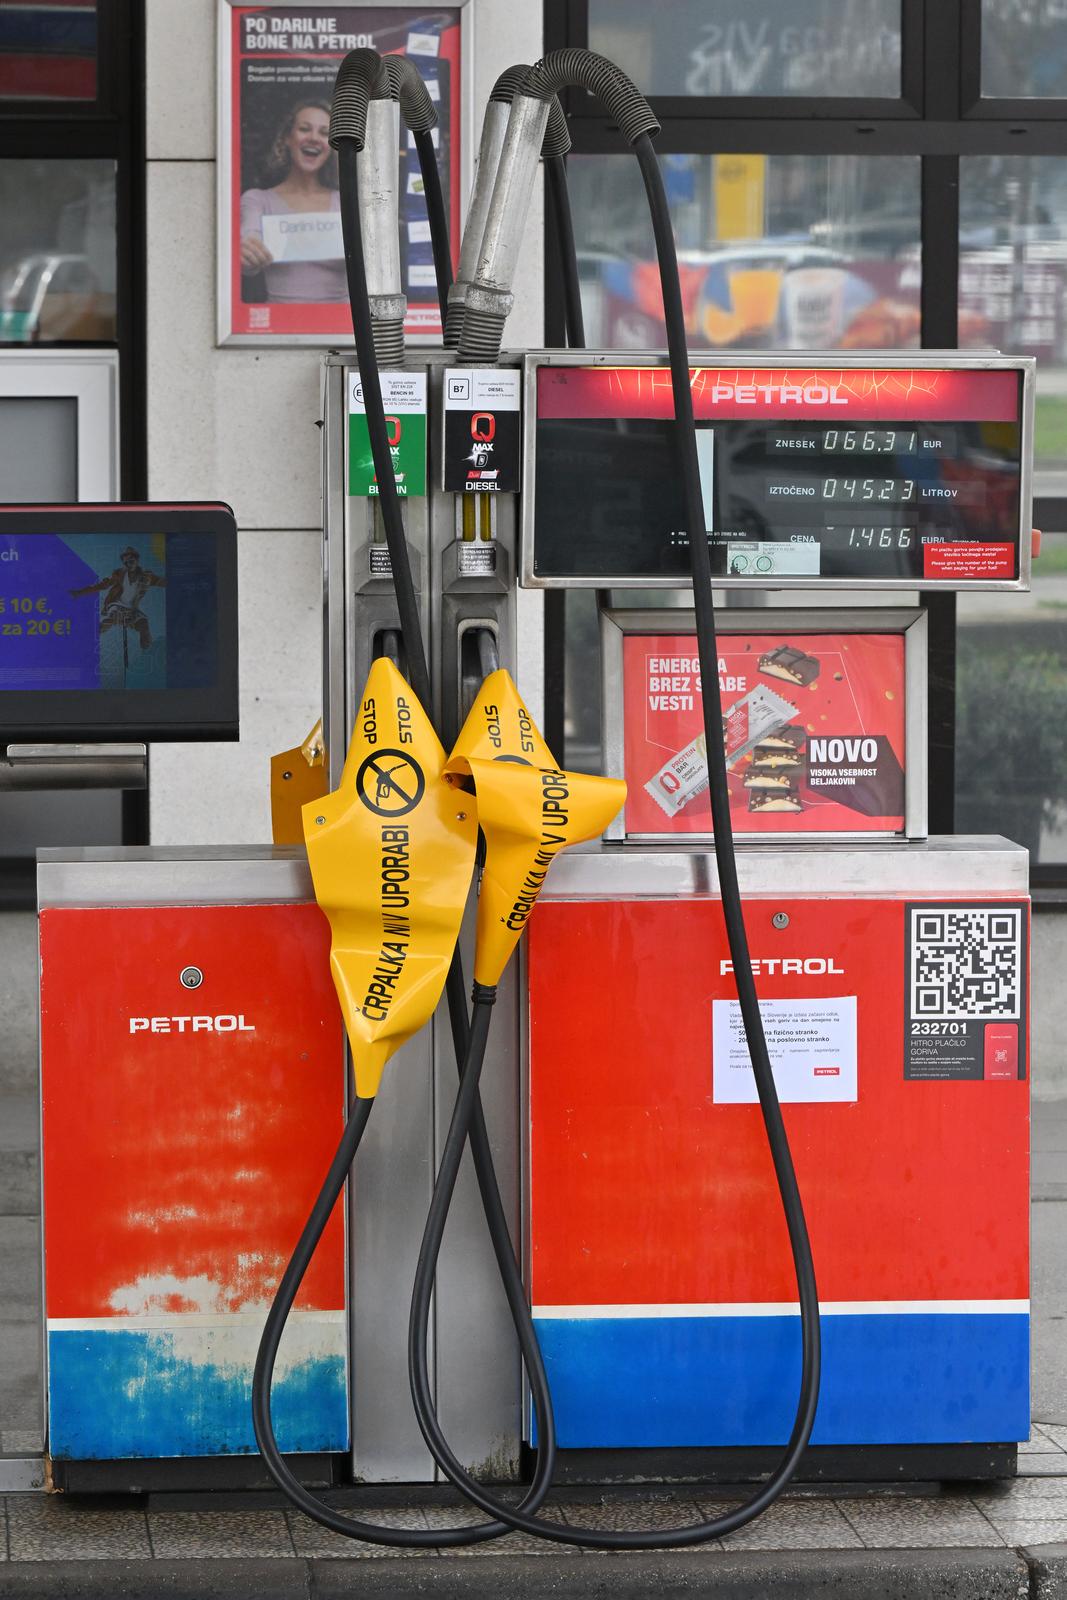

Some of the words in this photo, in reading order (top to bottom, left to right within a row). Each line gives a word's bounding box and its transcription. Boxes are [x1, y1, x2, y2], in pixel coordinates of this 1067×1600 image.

[246, 18, 267, 32] PO
[271, 18, 337, 32] DARILNE
[246, 34, 288, 49] BONE
[292, 34, 314, 49] NA
[320, 34, 376, 49] PETROL
[712, 386, 848, 404] PETROL
[471, 412, 496, 442] Q
[472, 443, 494, 452] MAX
[776, 440, 816, 449] ZNESEK
[923, 440, 942, 448] EUR
[466, 482, 501, 491] DIESEL
[769, 486, 815, 496] IZTOČENO
[922, 488, 958, 497] LITROV
[2, 624, 22, 635] za
[650, 658, 728, 673] ENERGA
[650, 677, 690, 692] BREZ
[695, 677, 746, 692] SABE
[649, 696, 694, 710] VESTI
[363, 698, 377, 744] STOP
[397, 697, 413, 744] STOP
[484, 705, 501, 748] STOP
[518, 708, 534, 752] STOP
[672, 747, 696, 770] PROTEIN
[810, 739, 878, 763] NOVO
[676, 762, 689, 774] BAR
[541, 833, 566, 846] V
[382, 825, 410, 908] UPORABI
[382, 913, 409, 921] V
[383, 922, 410, 937] NI
[355, 942, 409, 1022] ČRPALKA
[129, 1015, 256, 1033] PETROL
[911, 1022, 967, 1034] 232701
[935, 1039, 966, 1047] PLAČILO
